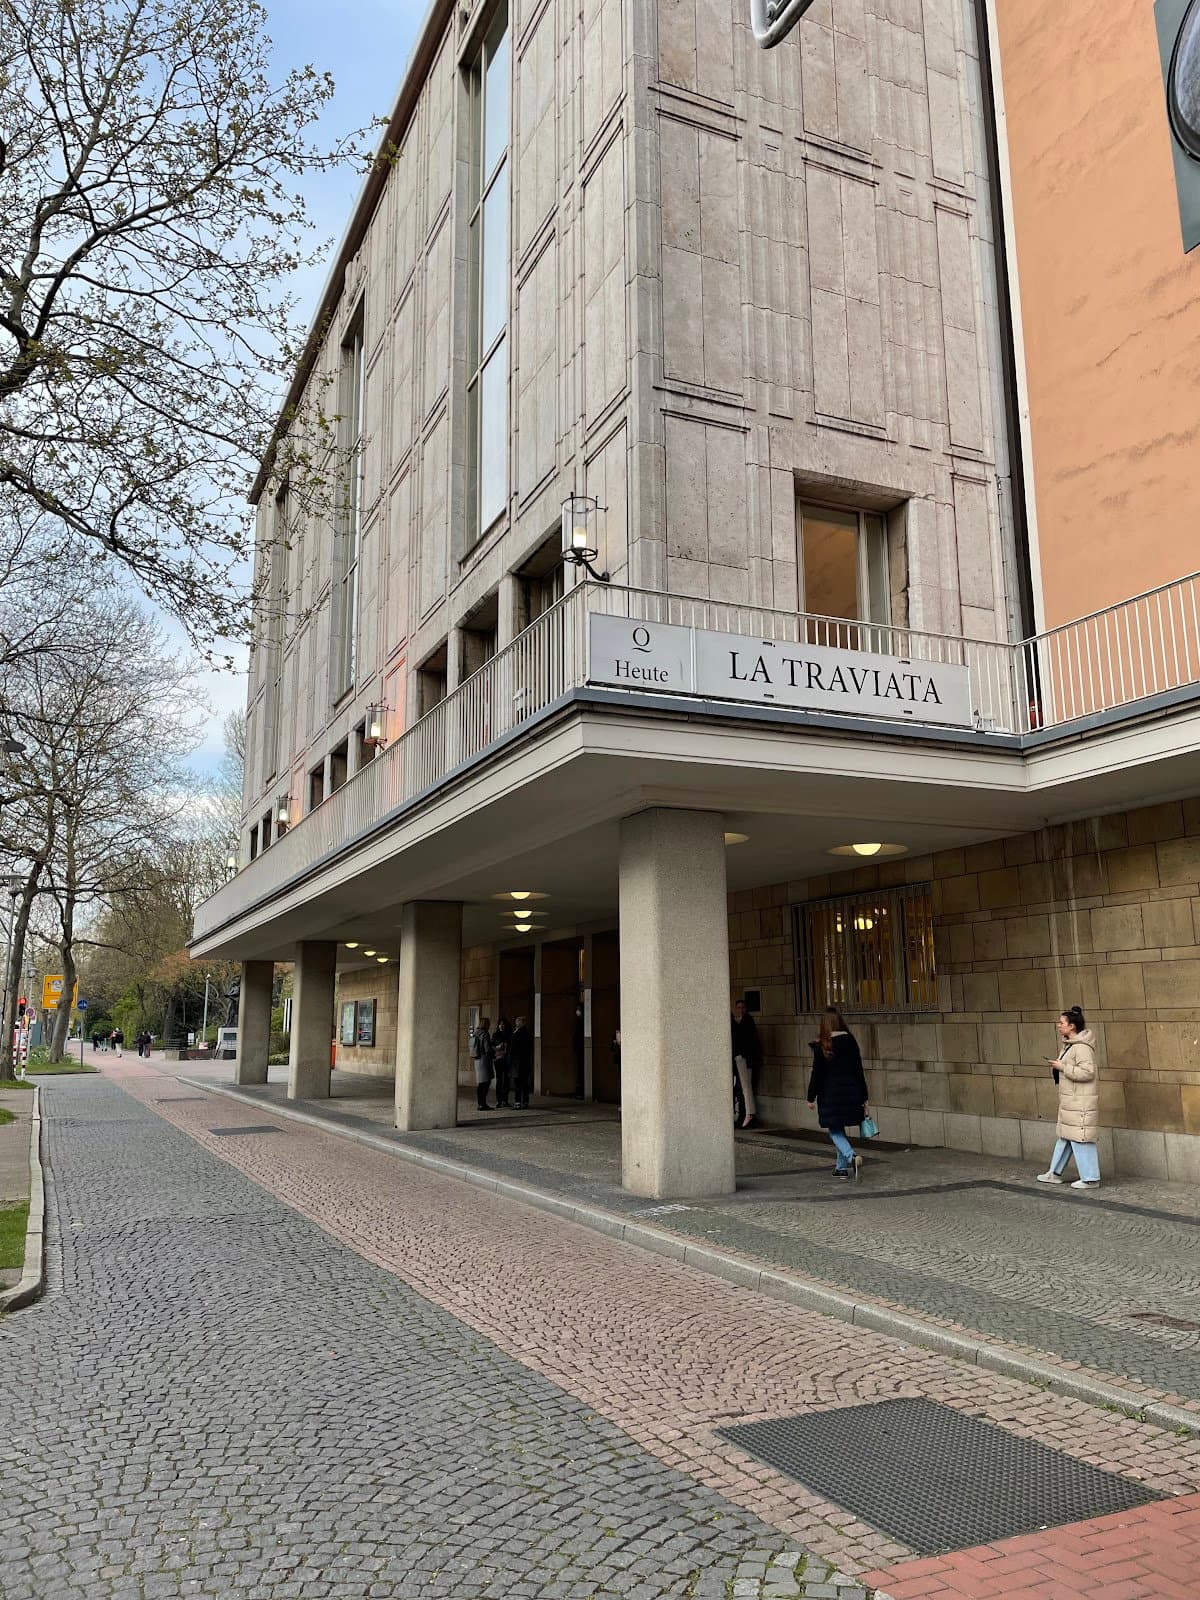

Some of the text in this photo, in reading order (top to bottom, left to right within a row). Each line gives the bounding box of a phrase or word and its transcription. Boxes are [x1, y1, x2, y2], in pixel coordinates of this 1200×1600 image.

[614, 659, 669, 682] Heute
[729, 651, 943, 704] LA TRAVIATA
